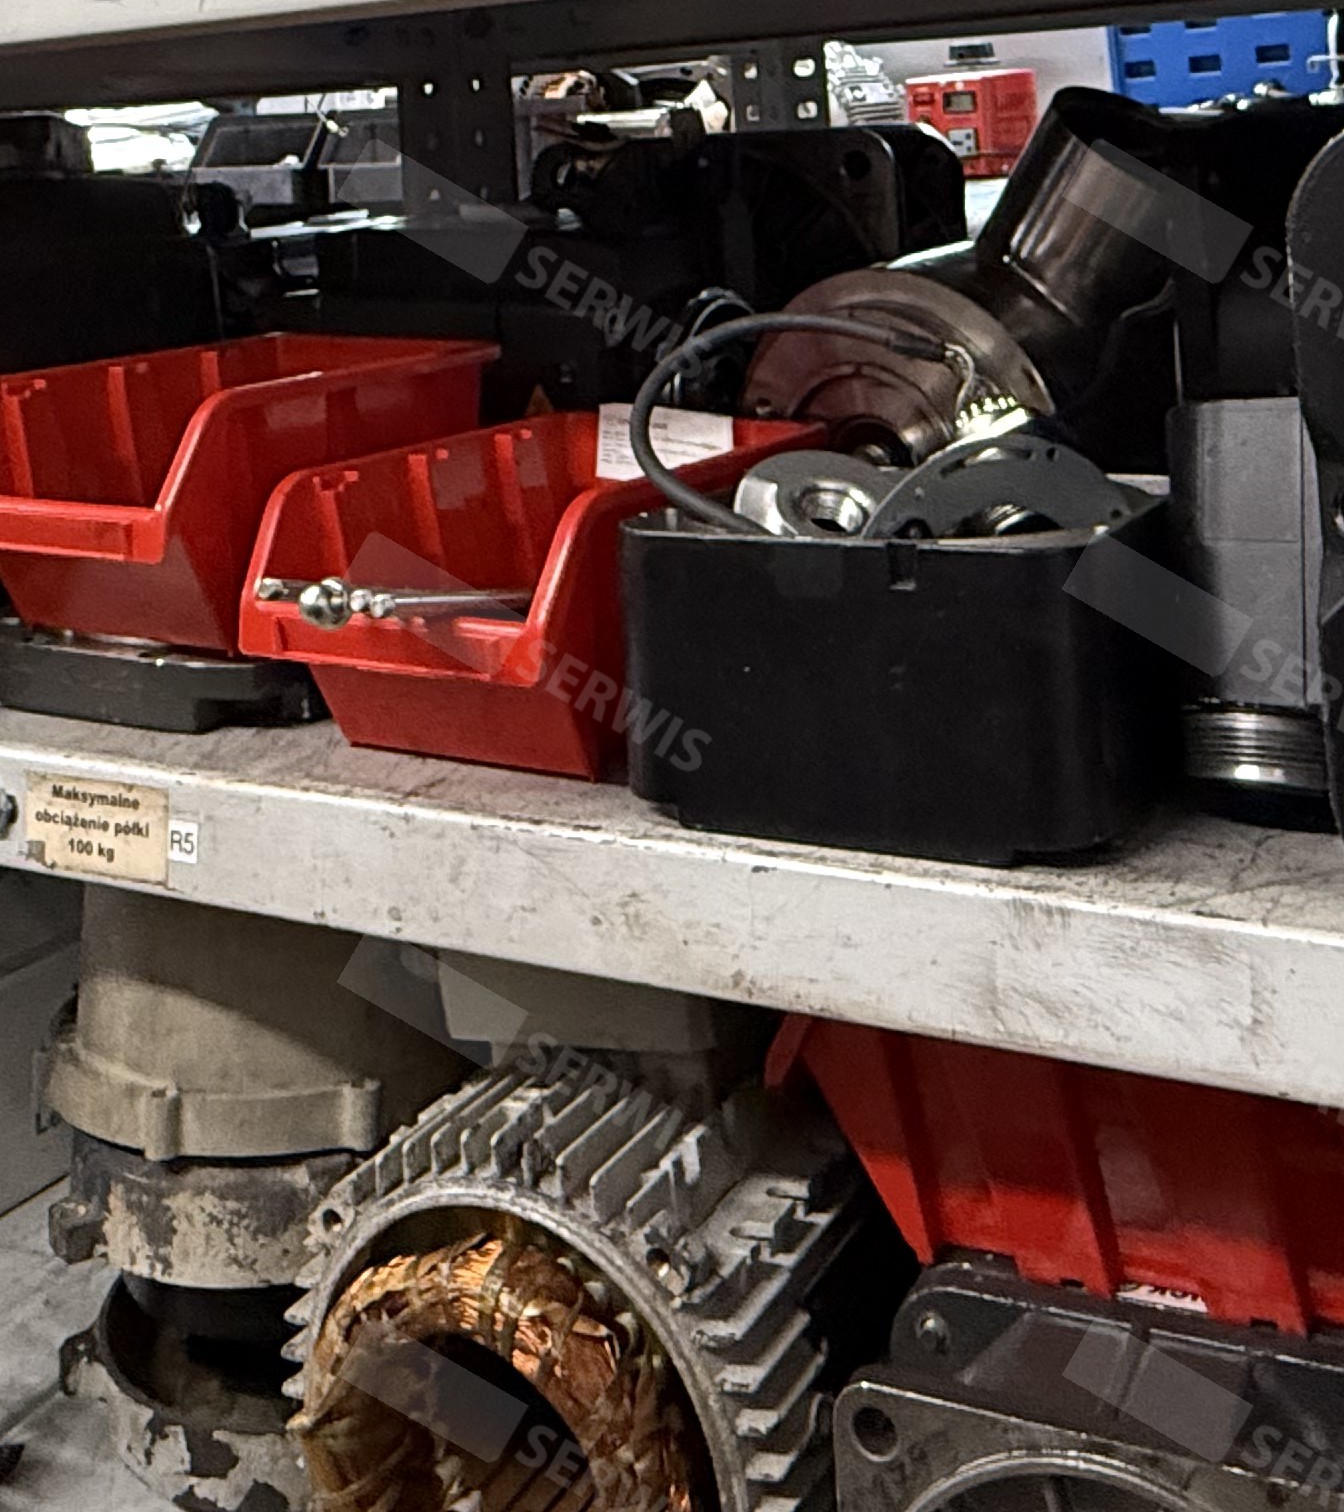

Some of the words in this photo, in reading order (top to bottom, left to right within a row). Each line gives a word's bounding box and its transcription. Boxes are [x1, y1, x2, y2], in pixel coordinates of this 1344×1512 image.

[51, 783, 141, 811] Maksymalne
[34, 808, 111, 833] obciążenie
[113, 818, 151, 839] półki
[68, 837, 94, 857] 100
[98, 842, 116, 864] kg
[169, 829, 196, 856] R5
